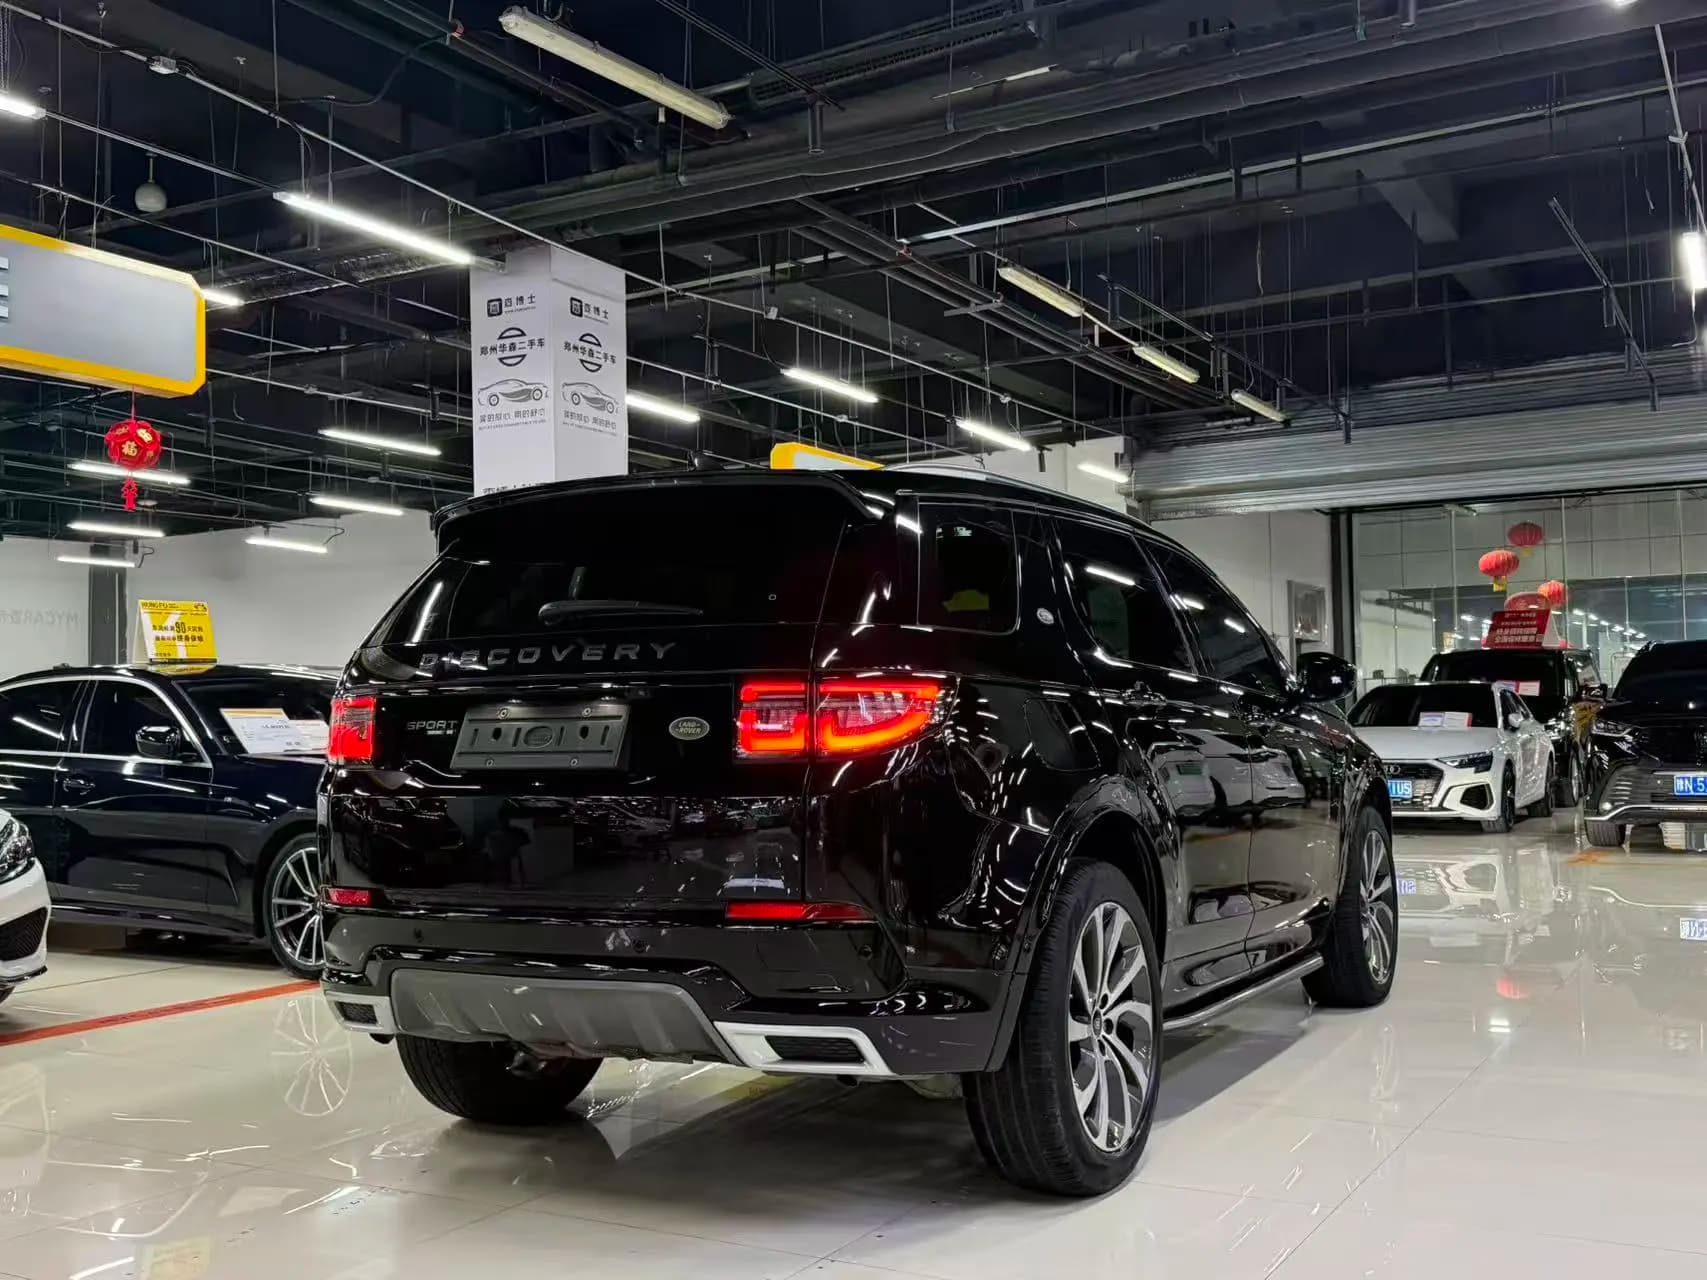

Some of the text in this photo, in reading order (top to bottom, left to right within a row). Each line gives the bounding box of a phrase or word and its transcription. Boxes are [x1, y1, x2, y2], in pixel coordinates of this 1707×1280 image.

[419, 643, 676, 669] DISCOVERY
[408, 720, 458, 730] SPORT
[679, 727, 702, 735] ROVER
